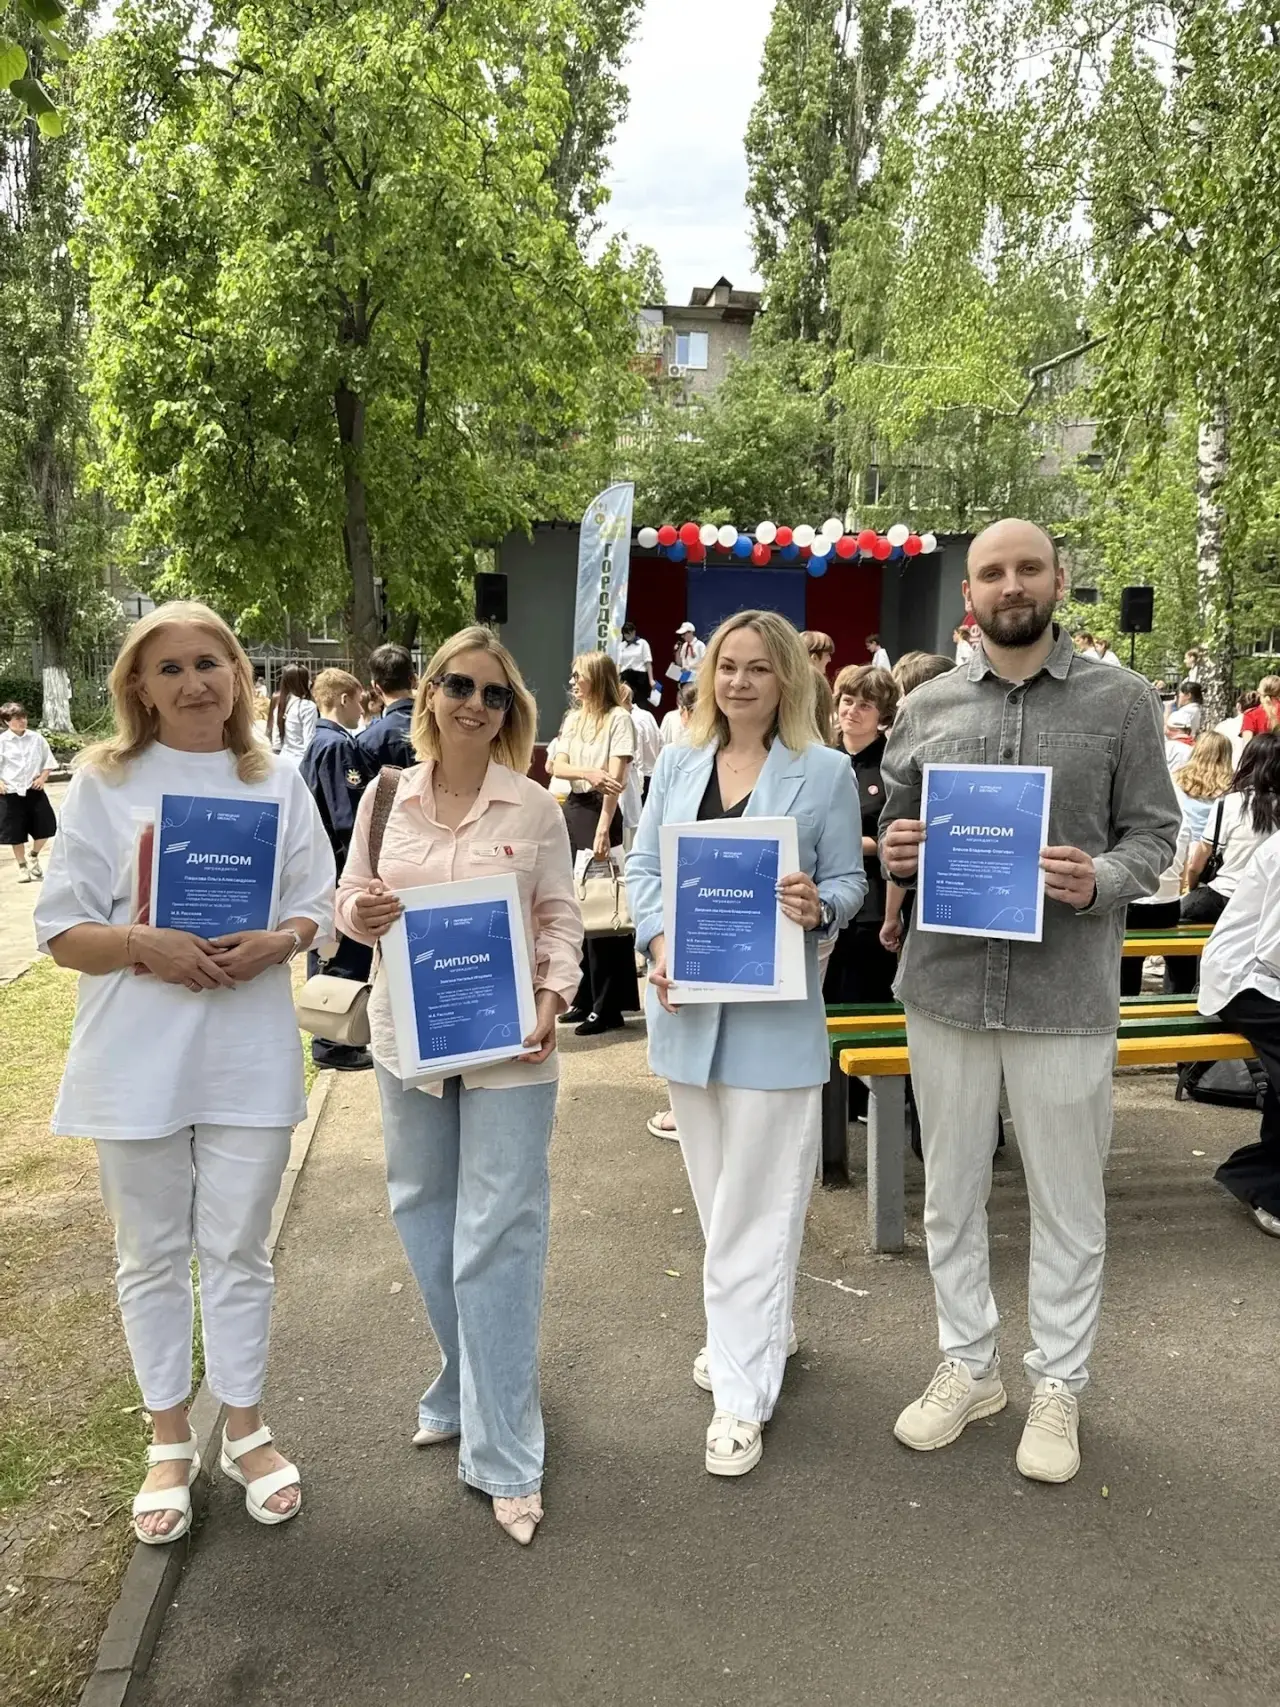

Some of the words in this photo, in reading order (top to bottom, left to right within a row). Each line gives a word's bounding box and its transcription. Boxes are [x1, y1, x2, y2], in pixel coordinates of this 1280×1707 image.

[949, 825, 1014, 837] ДИПЛОМ
[186, 852, 252, 866] ДИПЛОМ
[697, 887, 754, 899] ДИПЛОМ
[433, 953, 491, 970] ДИПЛОМ
